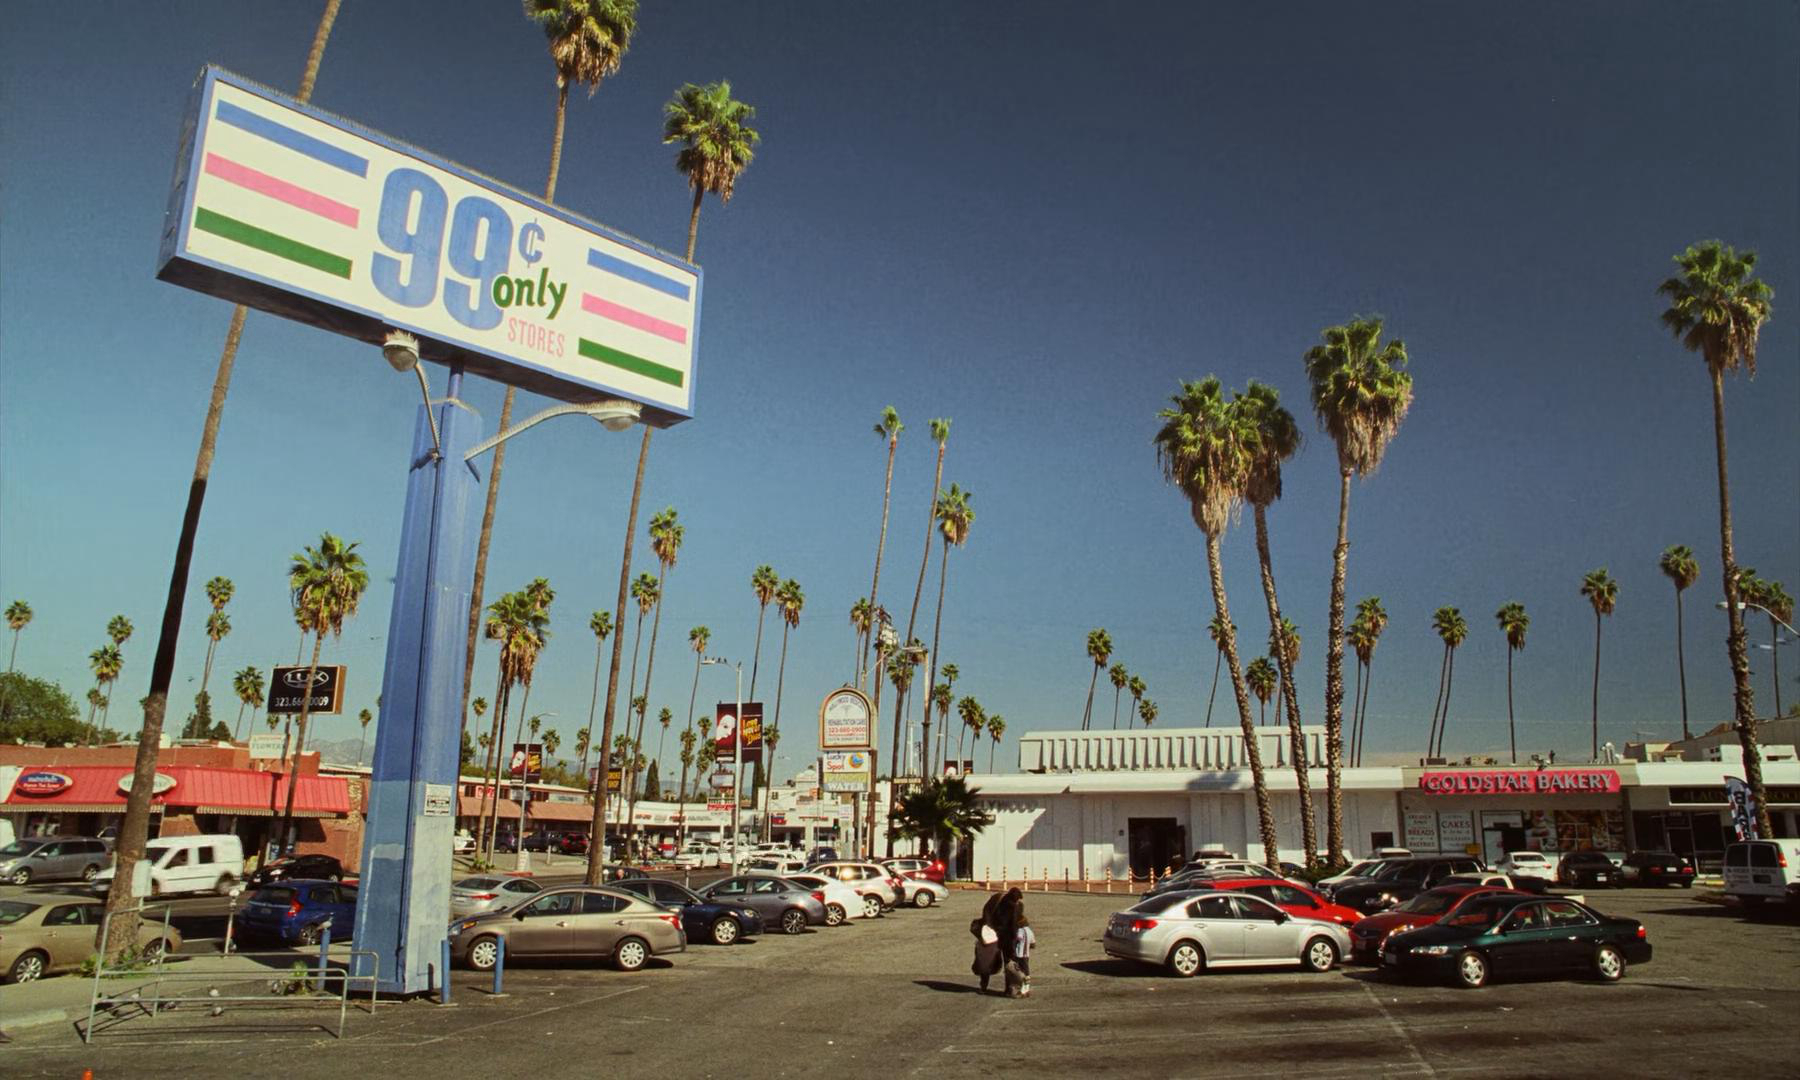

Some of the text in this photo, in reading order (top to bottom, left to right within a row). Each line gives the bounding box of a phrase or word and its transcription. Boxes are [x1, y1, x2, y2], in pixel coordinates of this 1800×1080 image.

[492, 267, 567, 320] only
[508, 316, 565, 359] STORES
[827, 761, 845, 773] Spot
[1427, 773, 1614, 791] GOLDSTAR BAKERY
[1441, 820, 1471, 829] CAKES
